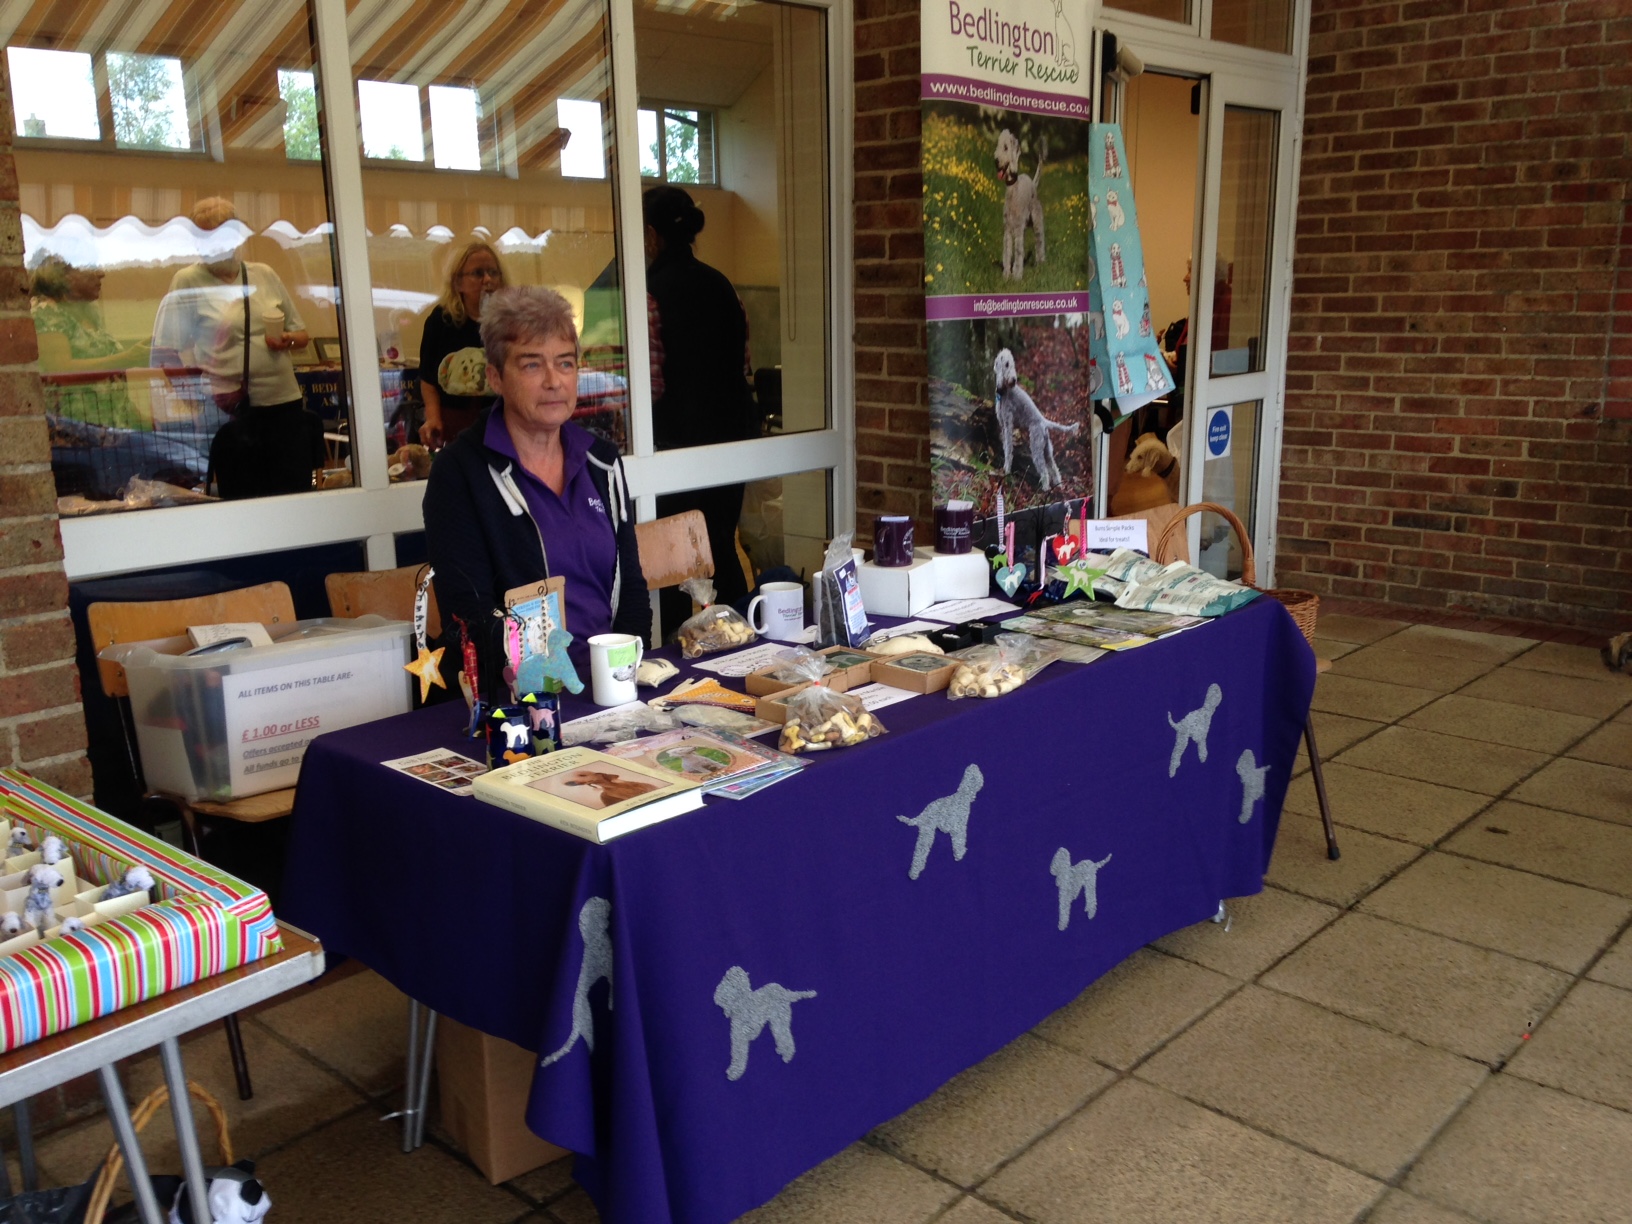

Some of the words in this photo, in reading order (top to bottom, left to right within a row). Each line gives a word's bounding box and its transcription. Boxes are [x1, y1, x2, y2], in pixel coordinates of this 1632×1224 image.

[949, 1, 1054, 57] Bedlington
[966, 46, 1019, 76] Terrier
[1025, 58, 1079, 84] Rescue
[930, 82, 1089, 115] www.bedlingtonrescue.co.u
[974, 297, 1078, 314] info@bedlingtonrescue.co.uk
[238, 690, 252, 699] ALL
[254, 685, 278, 696] ITEMS
[280, 683, 293, 692] ON
[295, 679, 311, 689] THIS
[313, 675, 335, 685] TABLE
[252, 724, 277, 738] 1.00
[280, 723, 292, 733] or
[295, 716, 320, 730] LESS
[243, 748, 268, 759] Offers
[269, 739, 303, 754] accepted
[244, 764, 255, 774] All
[256, 760, 278, 772] funds
[279, 758, 289, 768] go
[291, 756, 300, 764] to
[501, 752, 582, 780] BEDLINGTON
[529, 760, 579, 778] TERRIER
